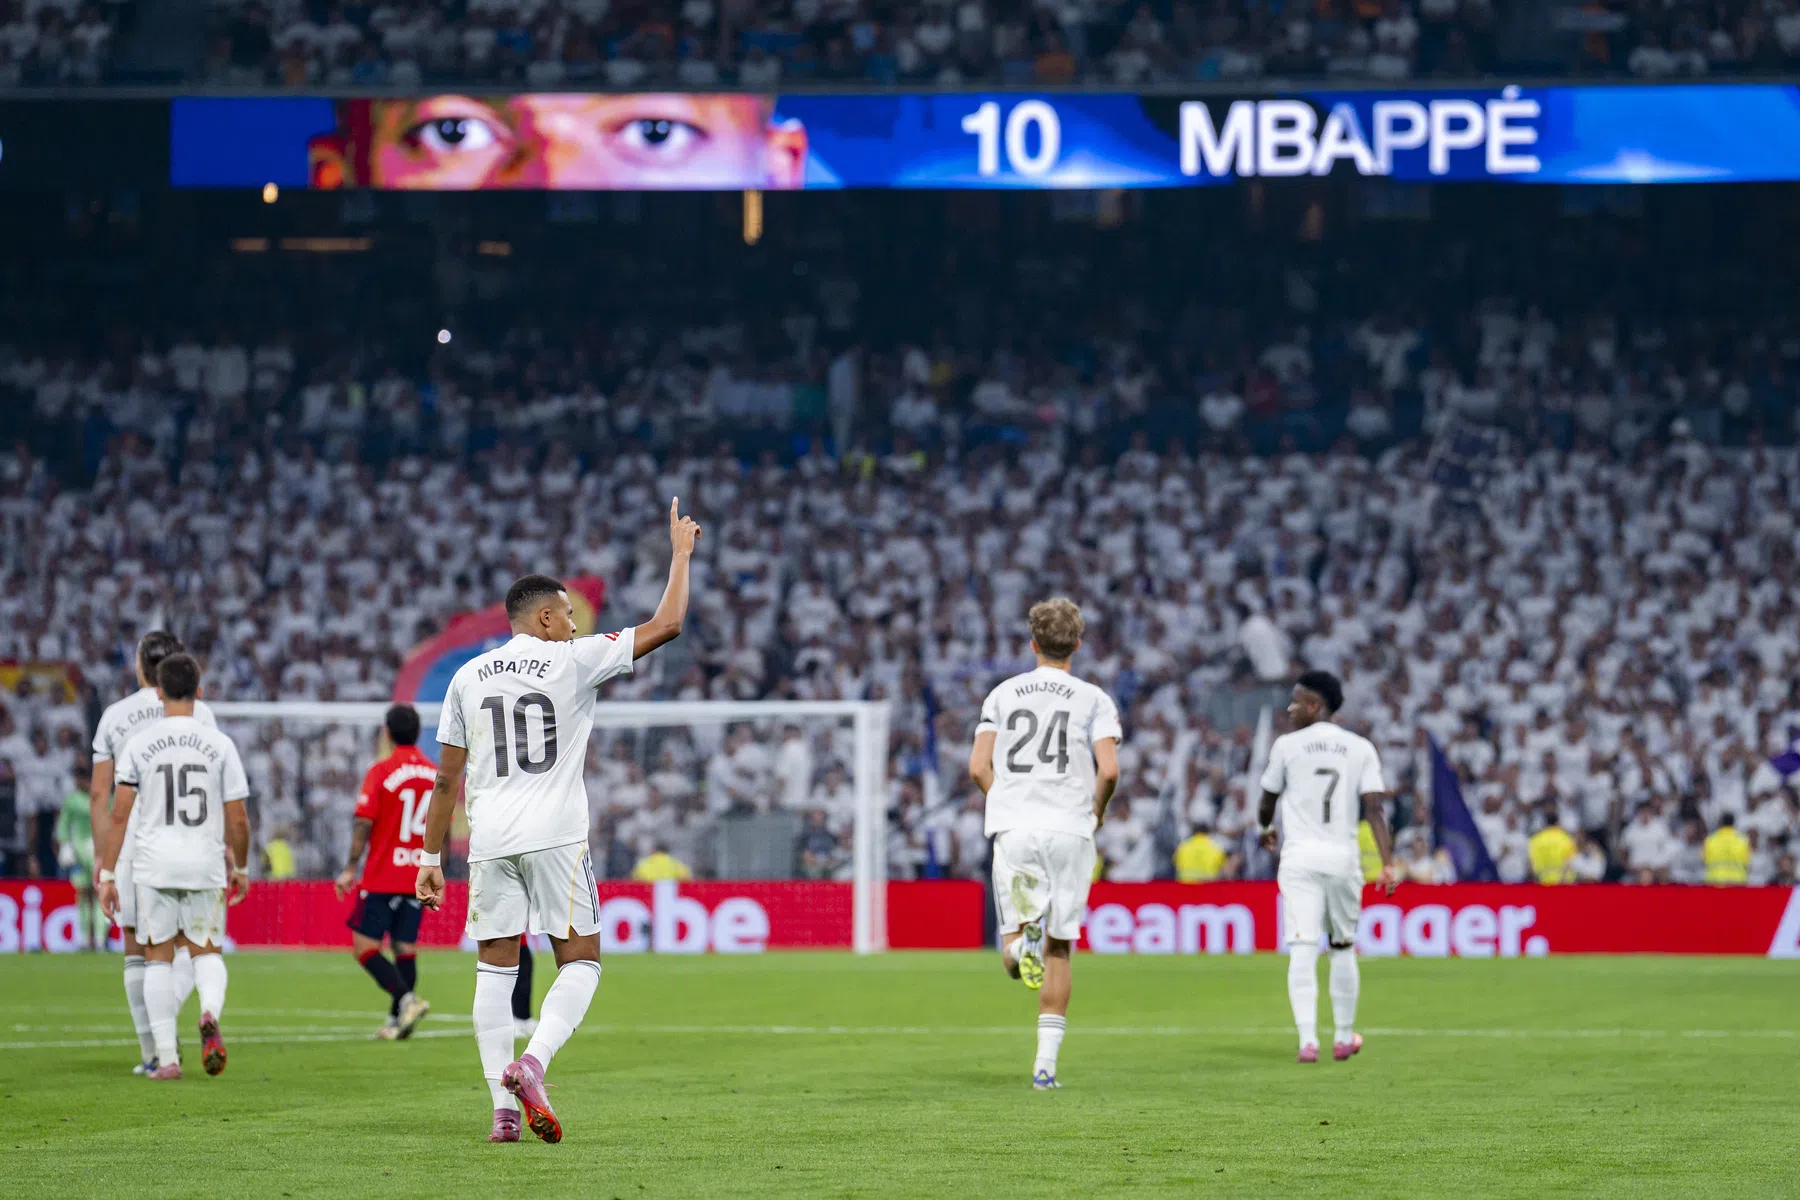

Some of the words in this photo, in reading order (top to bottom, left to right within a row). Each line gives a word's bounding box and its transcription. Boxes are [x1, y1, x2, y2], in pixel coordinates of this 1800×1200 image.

[962, 100, 1061, 176] 10
[1179, 84, 1541, 177] MBAPPÉ
[478, 659, 552, 682] MBAPPÉ
[1014, 682, 1075, 699] HUIJSEN
[127, 706, 164, 726] CARR
[480, 692, 558, 778] 10
[1006, 709, 1070, 774] 24
[141, 735, 176, 762] ARDA
[179, 732, 219, 762] GÜLER
[156, 764, 208, 827] 15
[1314, 768, 1340, 824] 7
